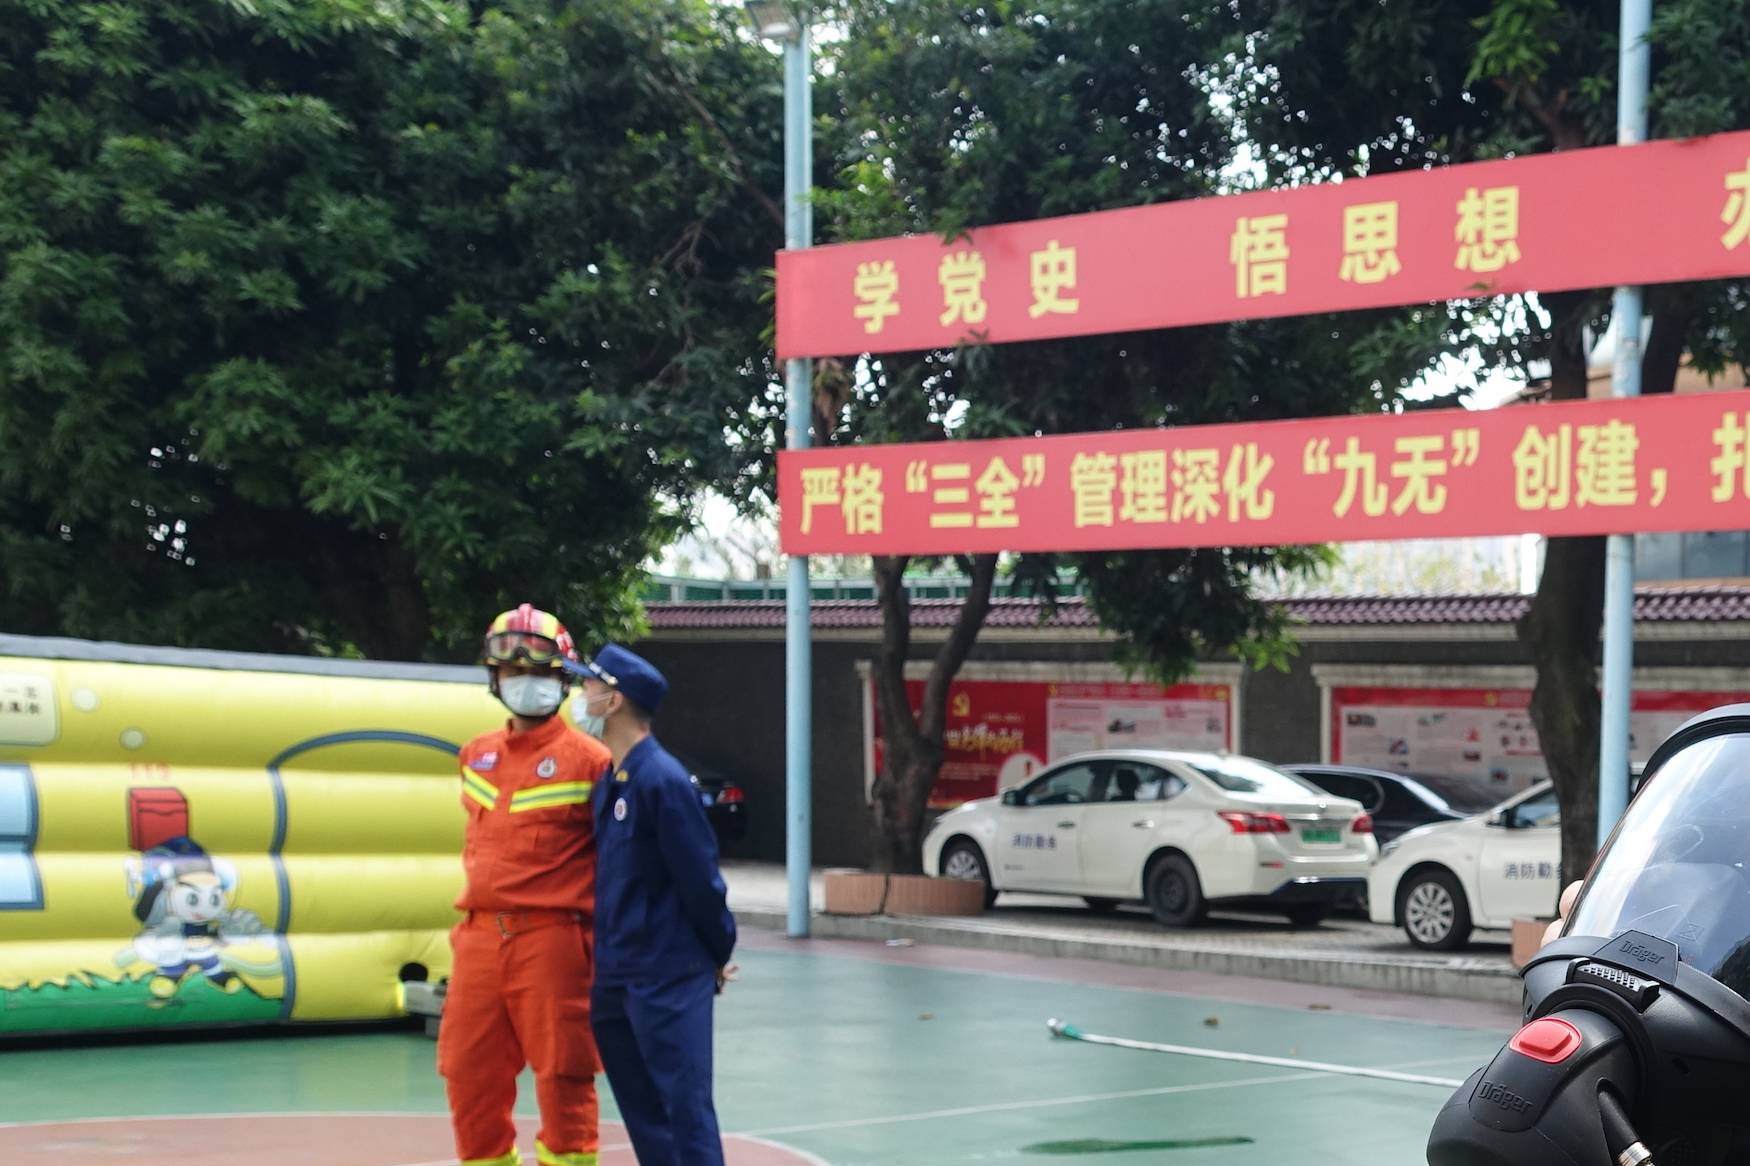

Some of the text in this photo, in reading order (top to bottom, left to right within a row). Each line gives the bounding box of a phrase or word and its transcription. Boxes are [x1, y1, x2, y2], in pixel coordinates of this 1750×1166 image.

[853, 239, 1080, 334] 学党史
[1230, 185, 1522, 299] 悟思想
[1619, 940, 1665, 964] Dräger
[1478, 1081, 1534, 1113] Dräger
